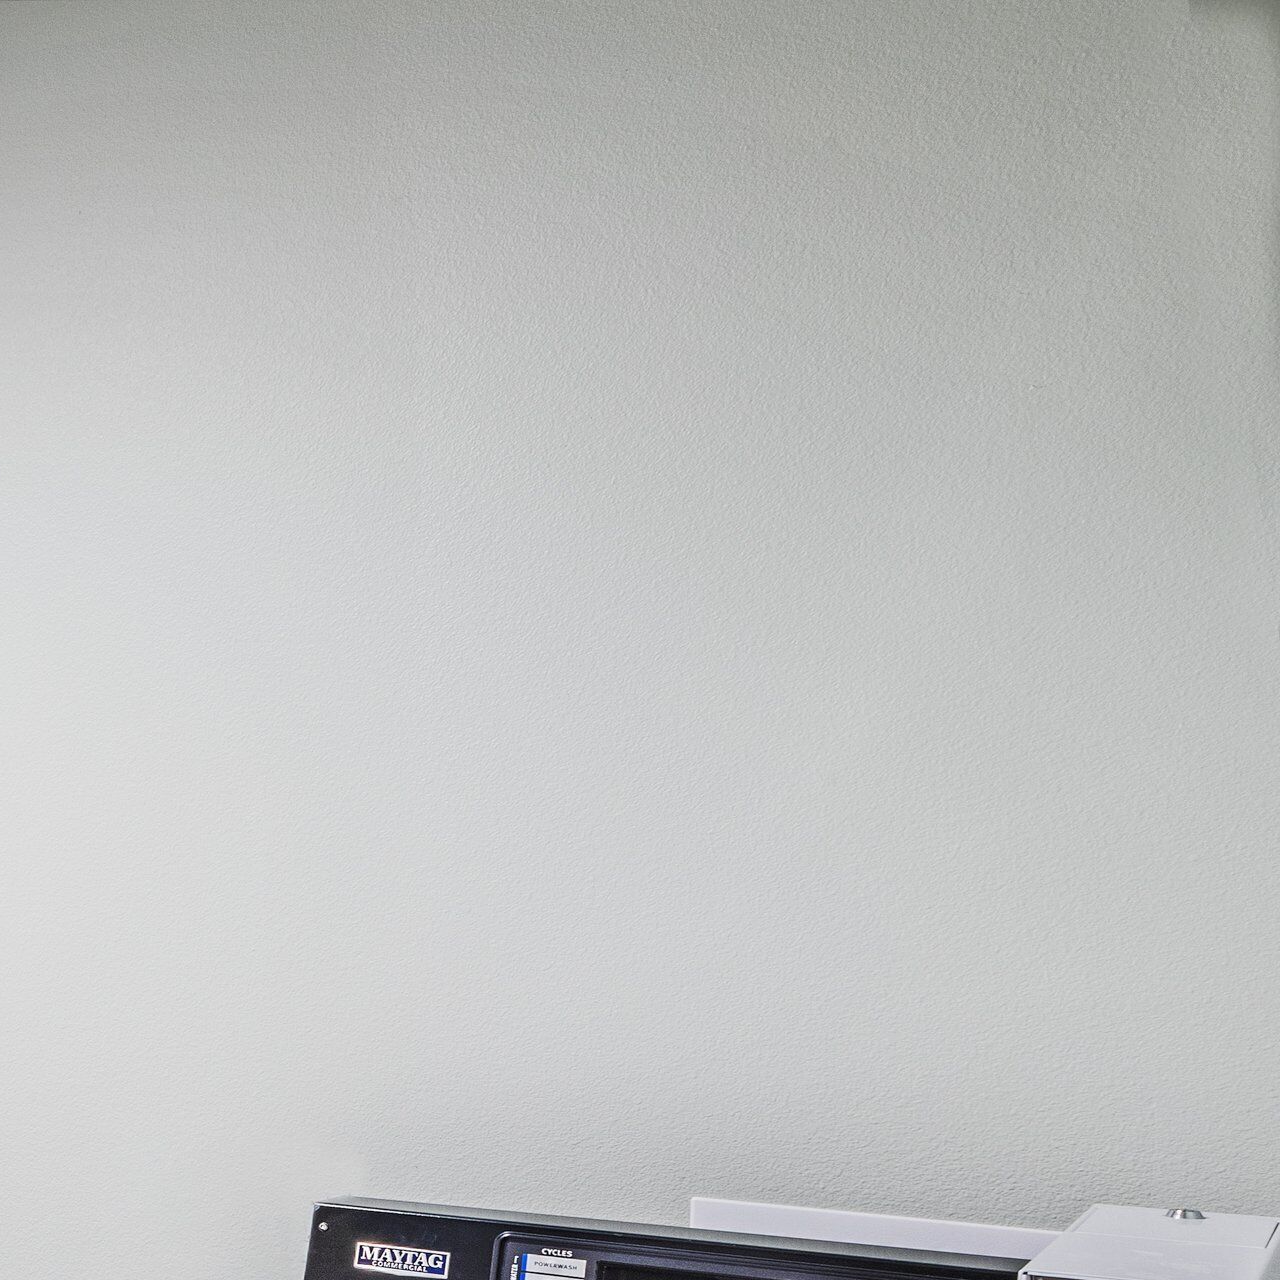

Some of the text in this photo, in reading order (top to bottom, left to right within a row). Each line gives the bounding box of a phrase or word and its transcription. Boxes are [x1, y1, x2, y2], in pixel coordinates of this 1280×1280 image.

[360, 1246, 444, 1269] MAYTAG
[541, 1248, 573, 1258] CYCLES
[371, 1260, 428, 1273] COMMERCIAL
[534, 1261, 578, 1270] POWERWASH
